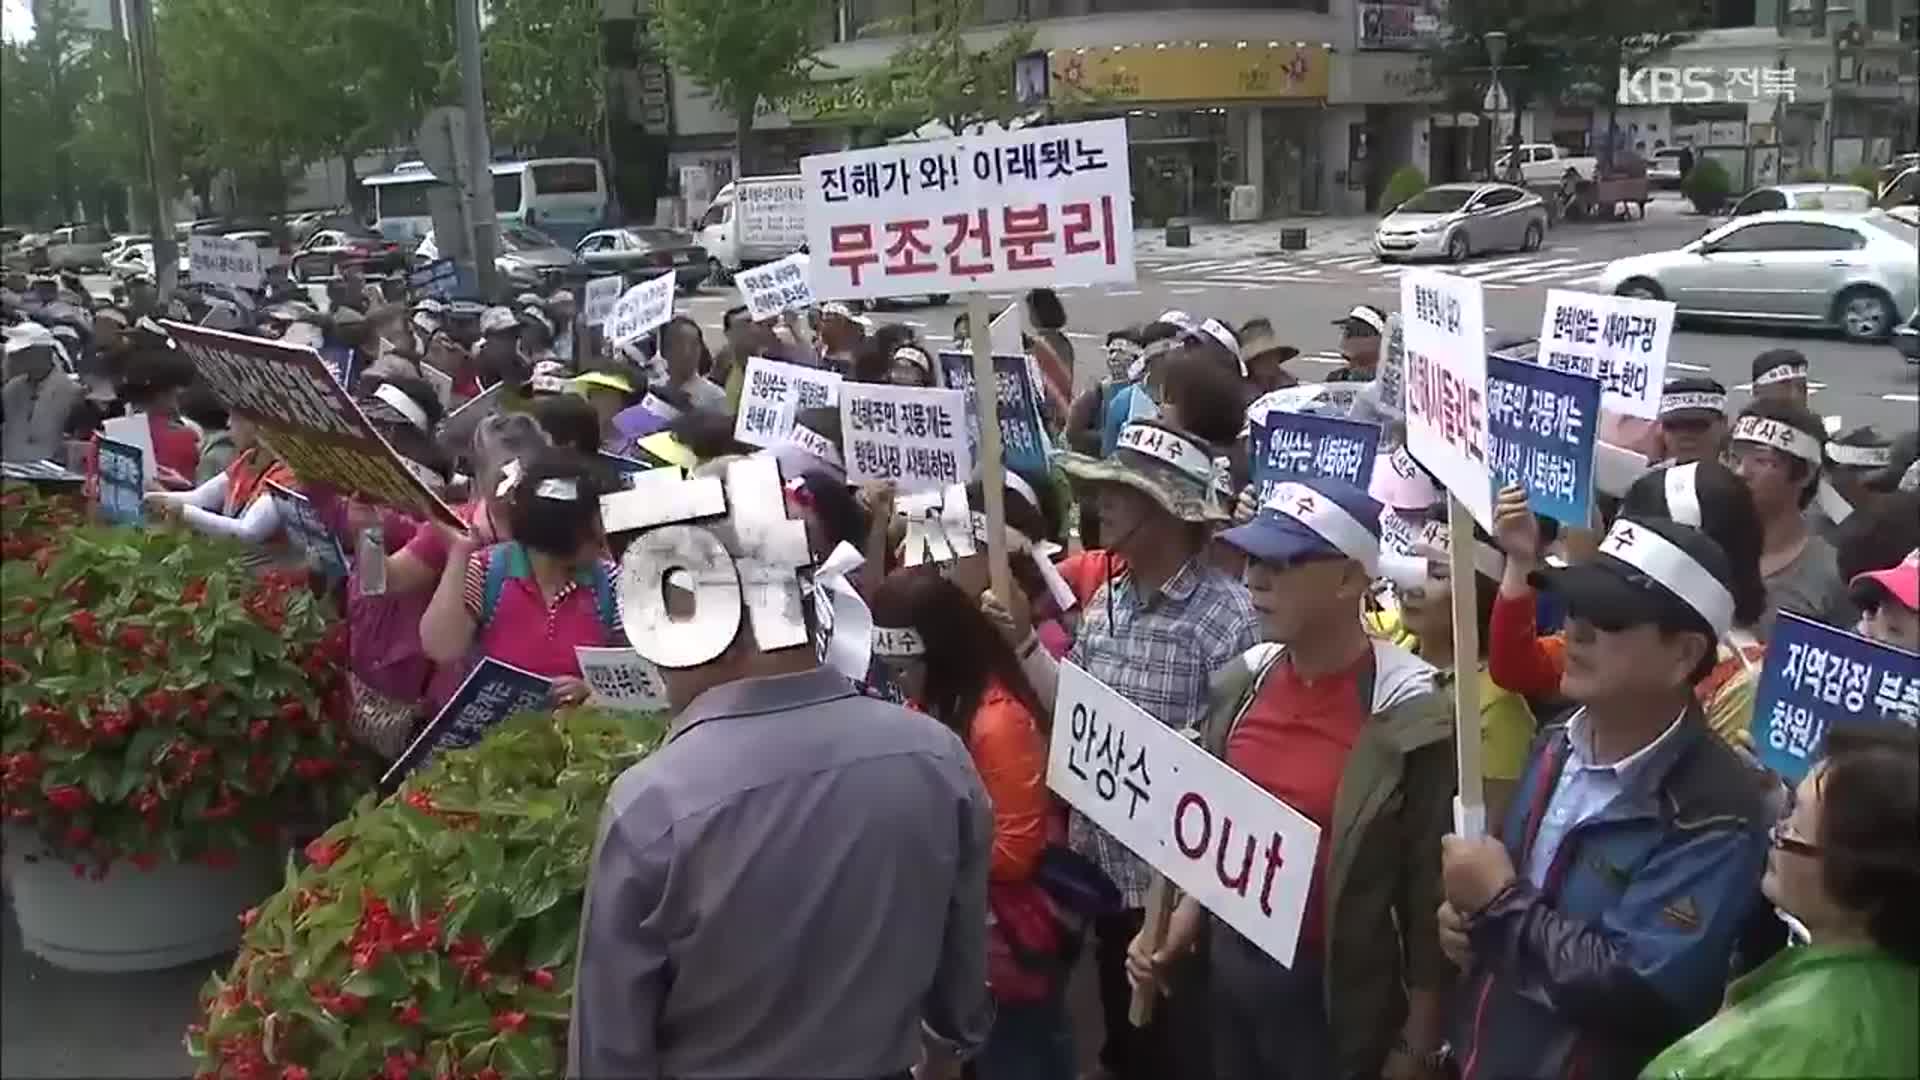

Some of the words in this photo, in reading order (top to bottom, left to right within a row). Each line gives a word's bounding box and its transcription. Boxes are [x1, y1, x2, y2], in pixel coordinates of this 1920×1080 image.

[820, 158, 911, 202] 진해가
[920, 155, 959, 190] 와!
[829, 195, 1117, 287] 무조건분리
[1553, 304, 1599, 344] 원칙없는
[1602, 313, 1657, 352] 새야구장
[851, 397, 897, 434] 진해주민
[1488, 377, 1527, 428] 해주민
[854, 441, 901, 478] 창원시장
[906, 449, 957, 483] 사퇴하라
[1488, 433, 1521, 488] 원시장
[1523, 446, 1577, 505] 사퇴하라
[877, 630, 917, 652] 사수
[1781, 643, 1873, 713] 지역감정
[1067, 702, 1151, 820] 안상수
